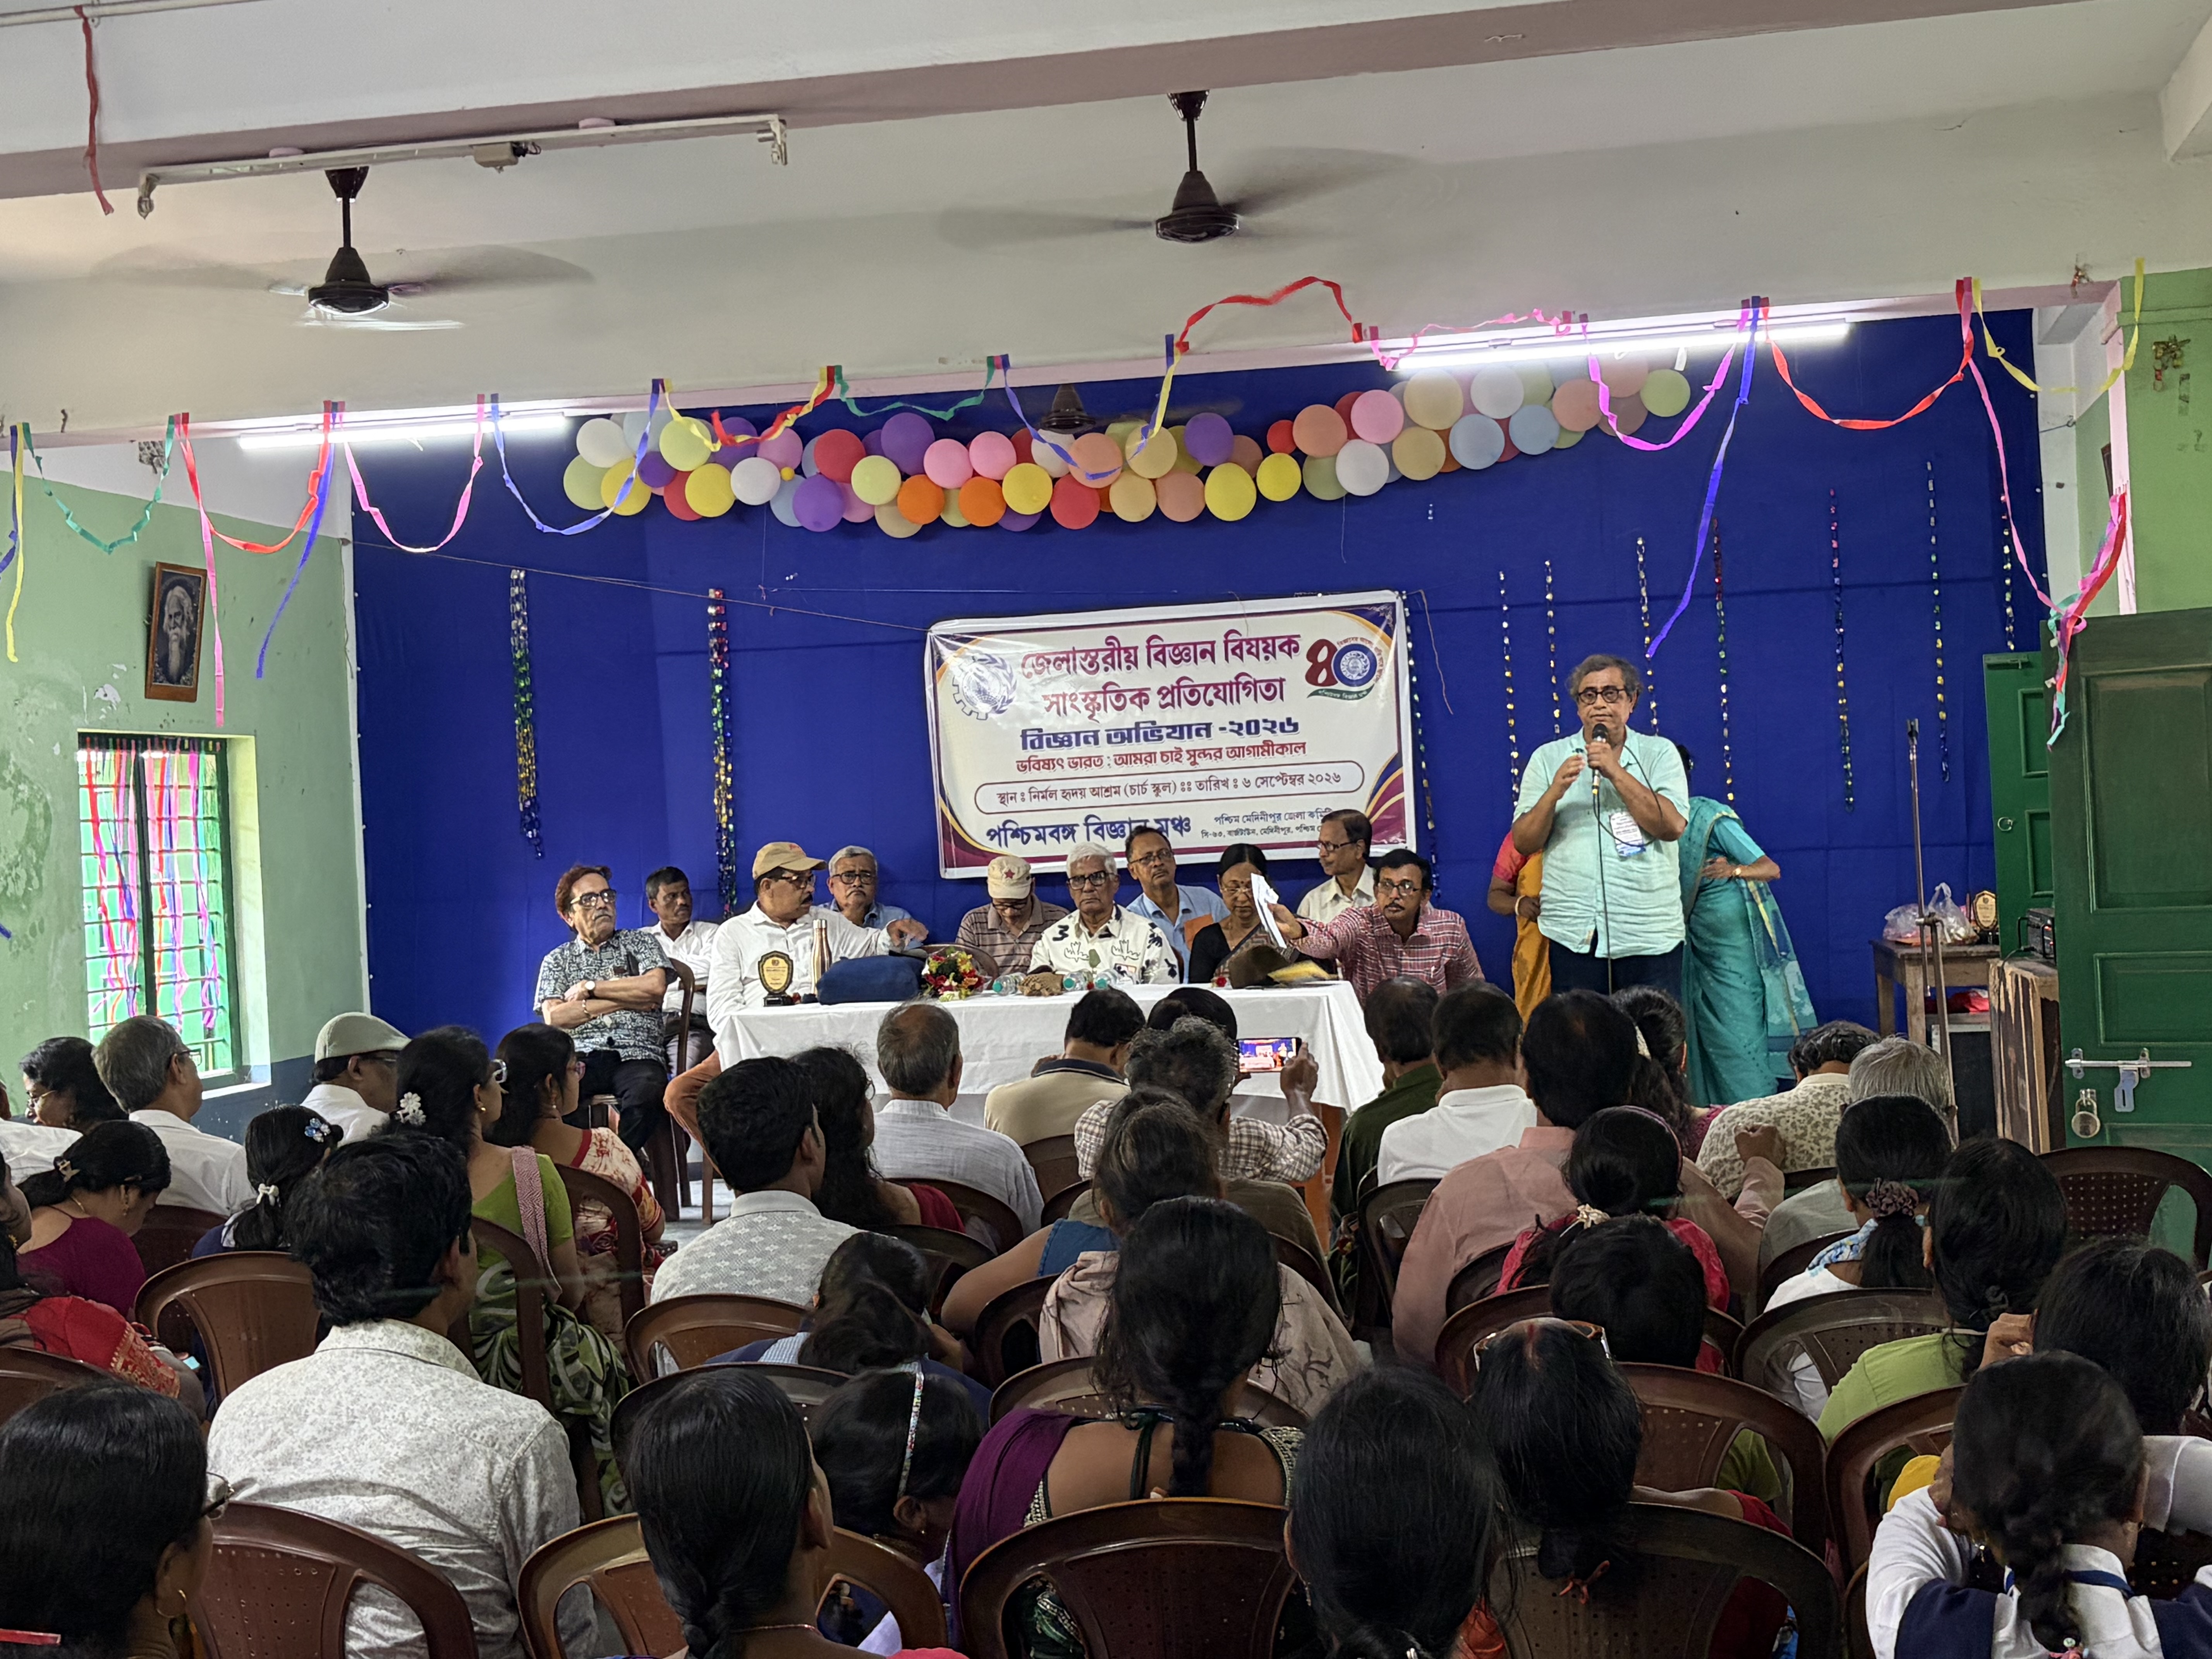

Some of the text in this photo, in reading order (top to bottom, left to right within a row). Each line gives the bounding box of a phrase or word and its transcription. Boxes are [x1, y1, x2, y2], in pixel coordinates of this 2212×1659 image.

[1021, 629, 1301, 678] জেলাস্তরীয় বিজ্ঞান বিষয়ক
[1042, 672, 1286, 723] সাংস্কৃতিক প্রতিযোগিতা
[1020, 717, 1298, 750] বিজ্ঞান অভিযান -২০২৬
[1016, 755, 1064, 773] ভবিষ্যৎ
[1068, 755, 1104, 769] ভারত
[1113, 752, 1157, 766] আমরা
[1160, 747, 1183, 764] চাই
[1186, 747, 1223, 766] সুন্দর
[1226, 740, 1306, 758] আগামীকাল
[996, 792, 1017, 807] স্থান
[1028, 786, 1058, 802] নির্মল
[1060, 788, 1086, 801] হৃদয়
[1089, 785, 1121, 798] আশ্রম
[1124, 779, 1148, 797] (চার্চ
[1151, 780, 1176, 797] স্কুল)
[1195, 775, 1229, 791] তারিখ
[1242, 778, 1251, 788] ৬
[1255, 772, 1305, 788] সেপ্টেম্বর
[1308, 773, 1341, 785] ২০২৬
[987, 819, 1079, 848] পশ্চিমবঙ্গ
[1154, 815, 1191, 837] মঞ্চ
[1214, 813, 1240, 824] পশ্চিম
[1242, 811, 1281, 823] মেদিনীপুর
[1284, 811, 1305, 821] জেলা
